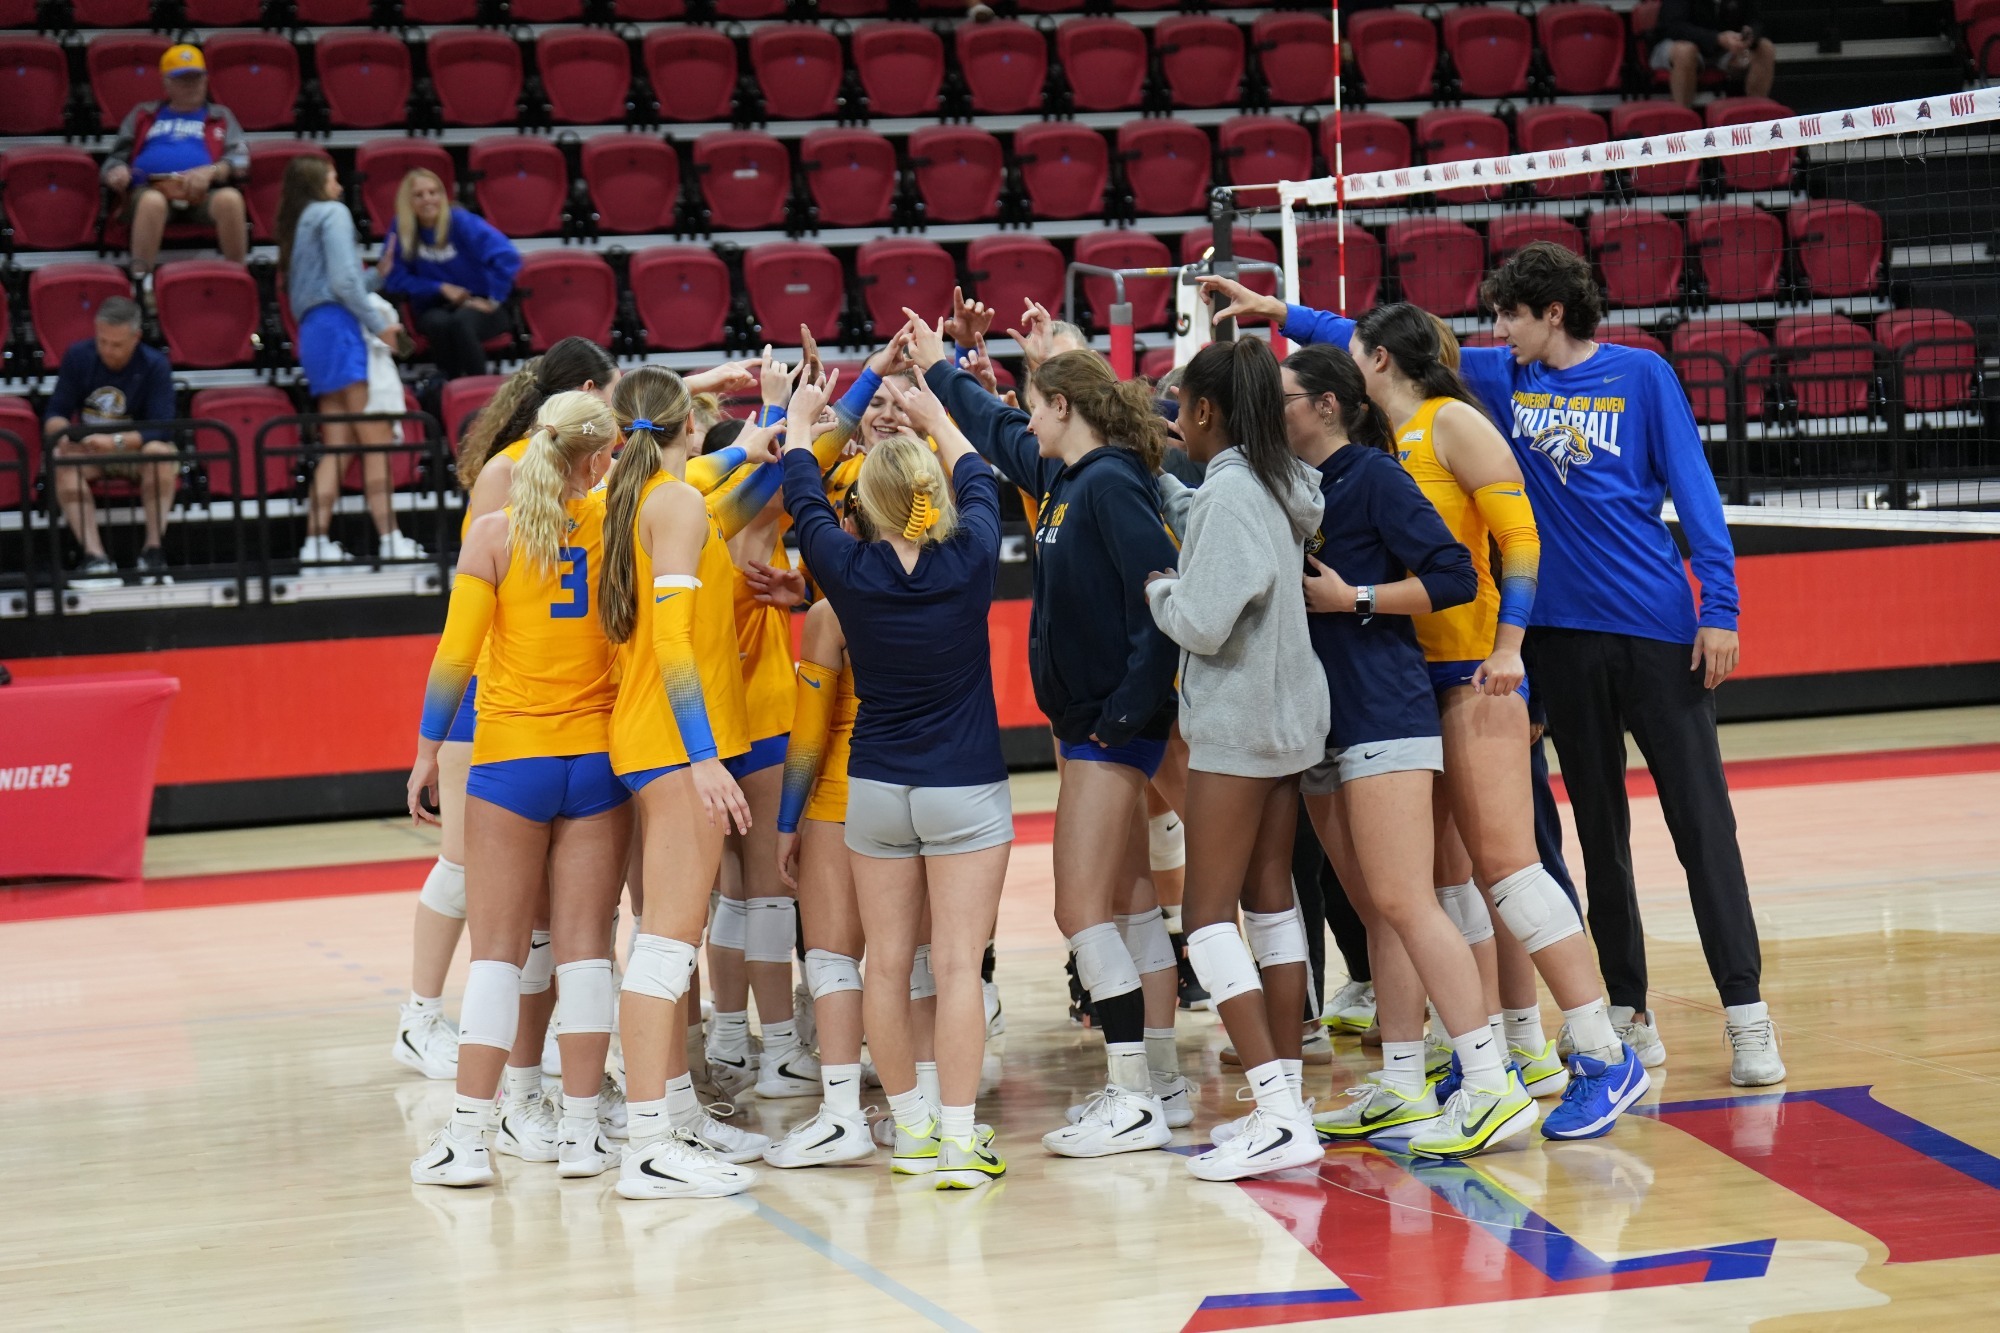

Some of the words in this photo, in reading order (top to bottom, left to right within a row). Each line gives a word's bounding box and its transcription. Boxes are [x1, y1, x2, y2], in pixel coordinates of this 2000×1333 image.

[1605, 143, 1625, 161] NJIT
[1666, 134, 1687, 154] NJIT
[1731, 126, 1753, 147] NJIT
[1799, 116, 1822, 138] NJIT
[1871, 105, 1896, 128] NJIT
[1949, 93, 1975, 117] NJIT
[1511, 399, 1621, 458] VOLLEYBALL
[1553, 395, 1567, 409] OF
[1568, 396, 1592, 412] NEW
[1593, 397, 1626, 413] HAVEN
[550, 546, 589, 618] 3
